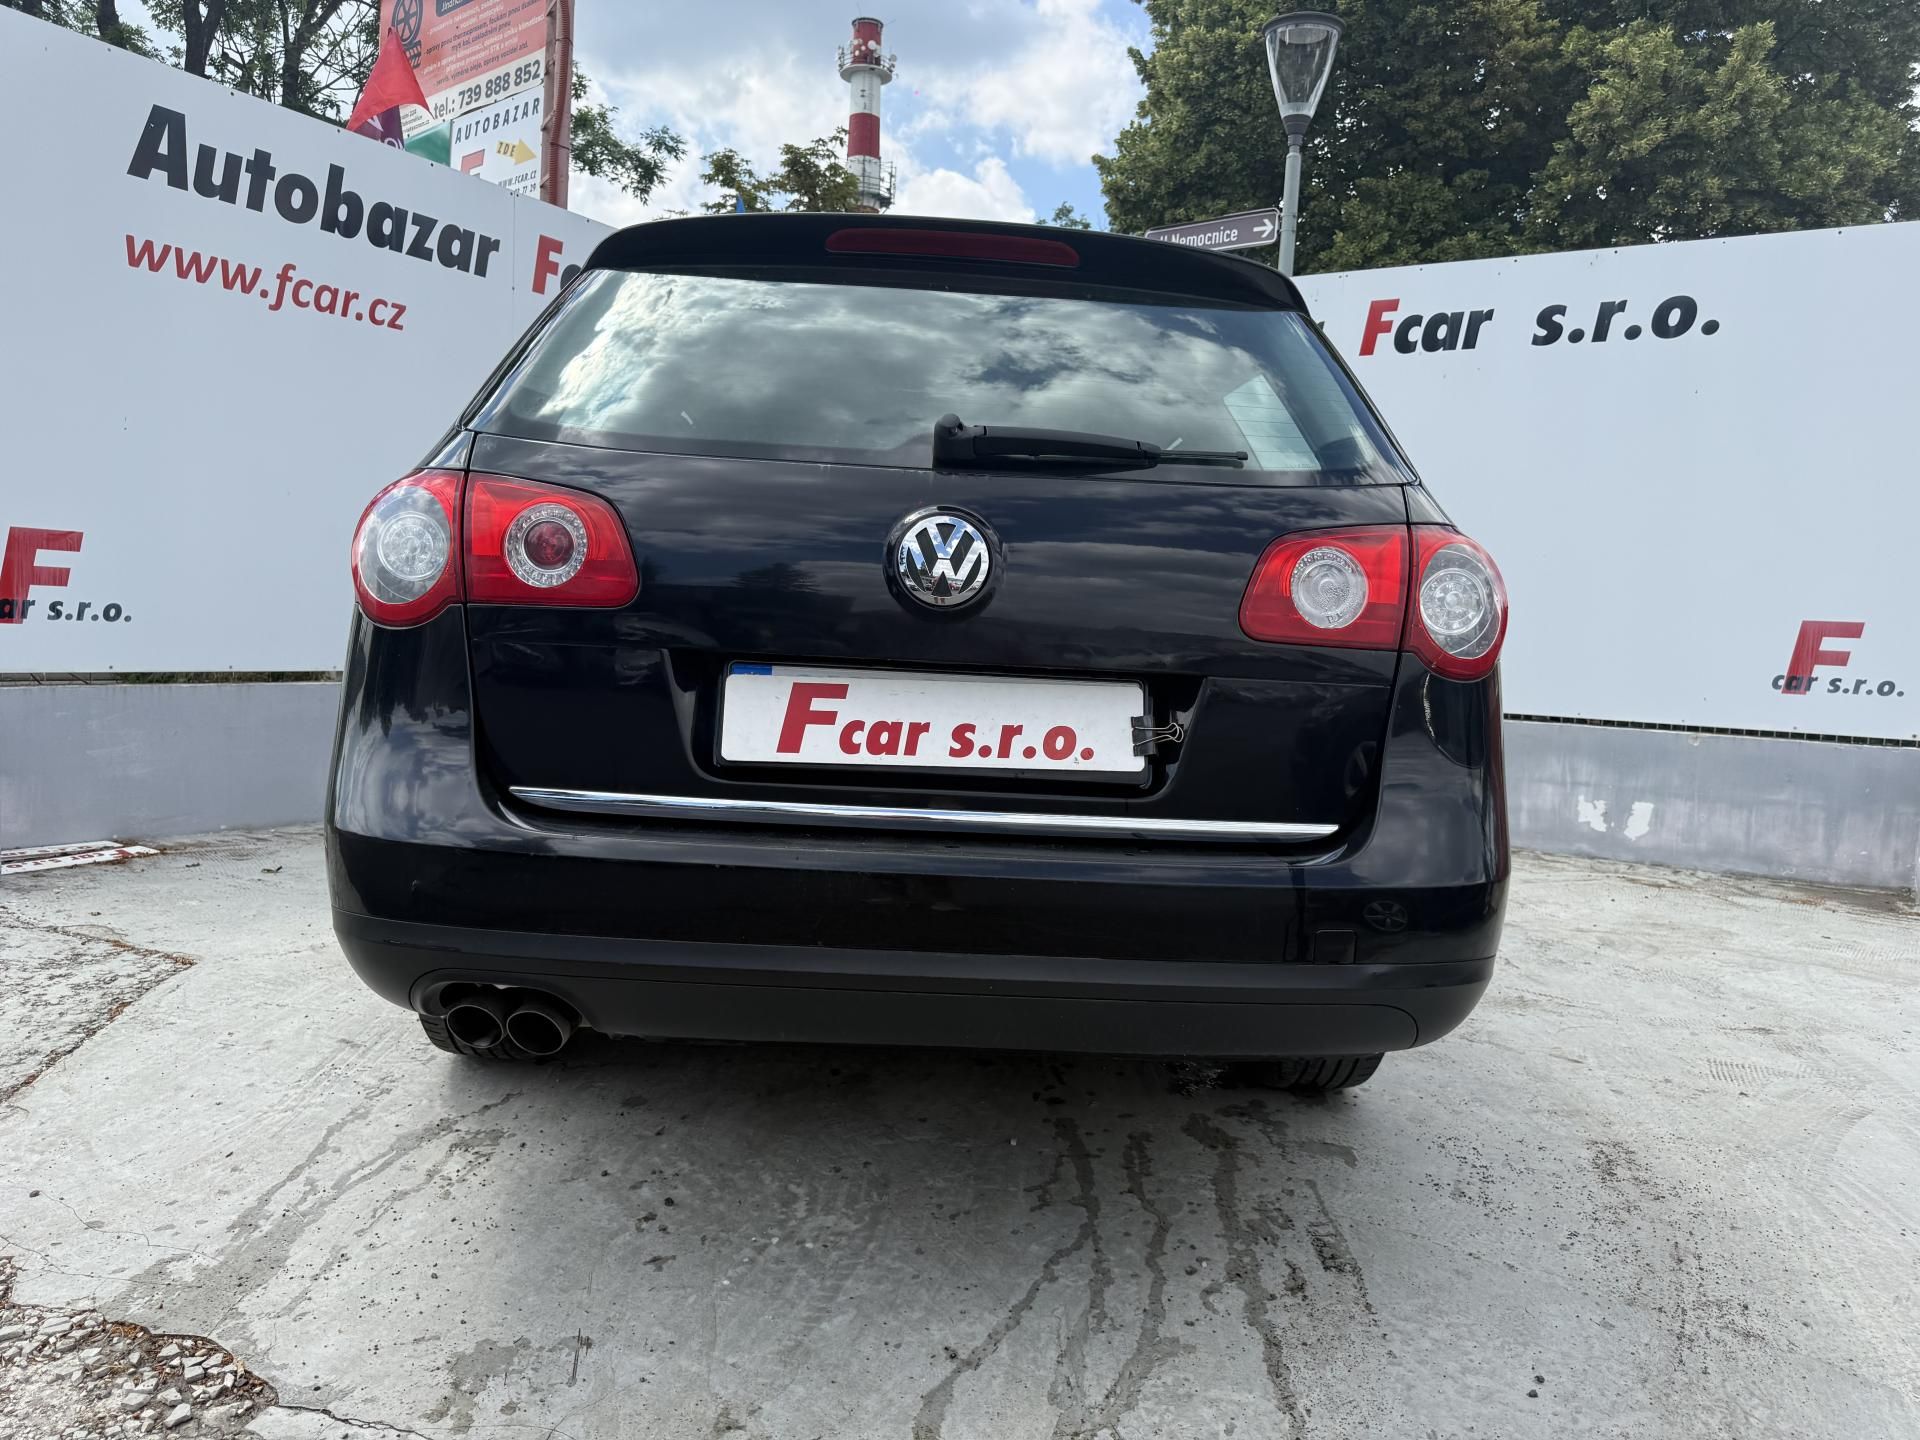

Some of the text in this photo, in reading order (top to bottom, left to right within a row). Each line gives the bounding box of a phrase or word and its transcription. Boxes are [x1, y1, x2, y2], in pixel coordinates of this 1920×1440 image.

[434, 102, 455, 118] tel.:
[458, 85, 482, 110] 739
[485, 73, 511, 98] 888
[514, 60, 541, 86] 852
[455, 97, 541, 144] AUTOBAZAR
[496, 141, 516, 157] ZDE
[126, 103, 500, 277] Autobazar
[1172, 226, 1238, 246] Nemocnice
[125, 234, 407, 331] www.fcar.cz
[1359, 294, 1721, 357] Fcar s.r.o.
[0, 598, 132, 622] ar s.r.o.
[1827, 677, 1905, 697] s.r.o.
[776, 682, 1095, 761] Fcar s.r.o.
